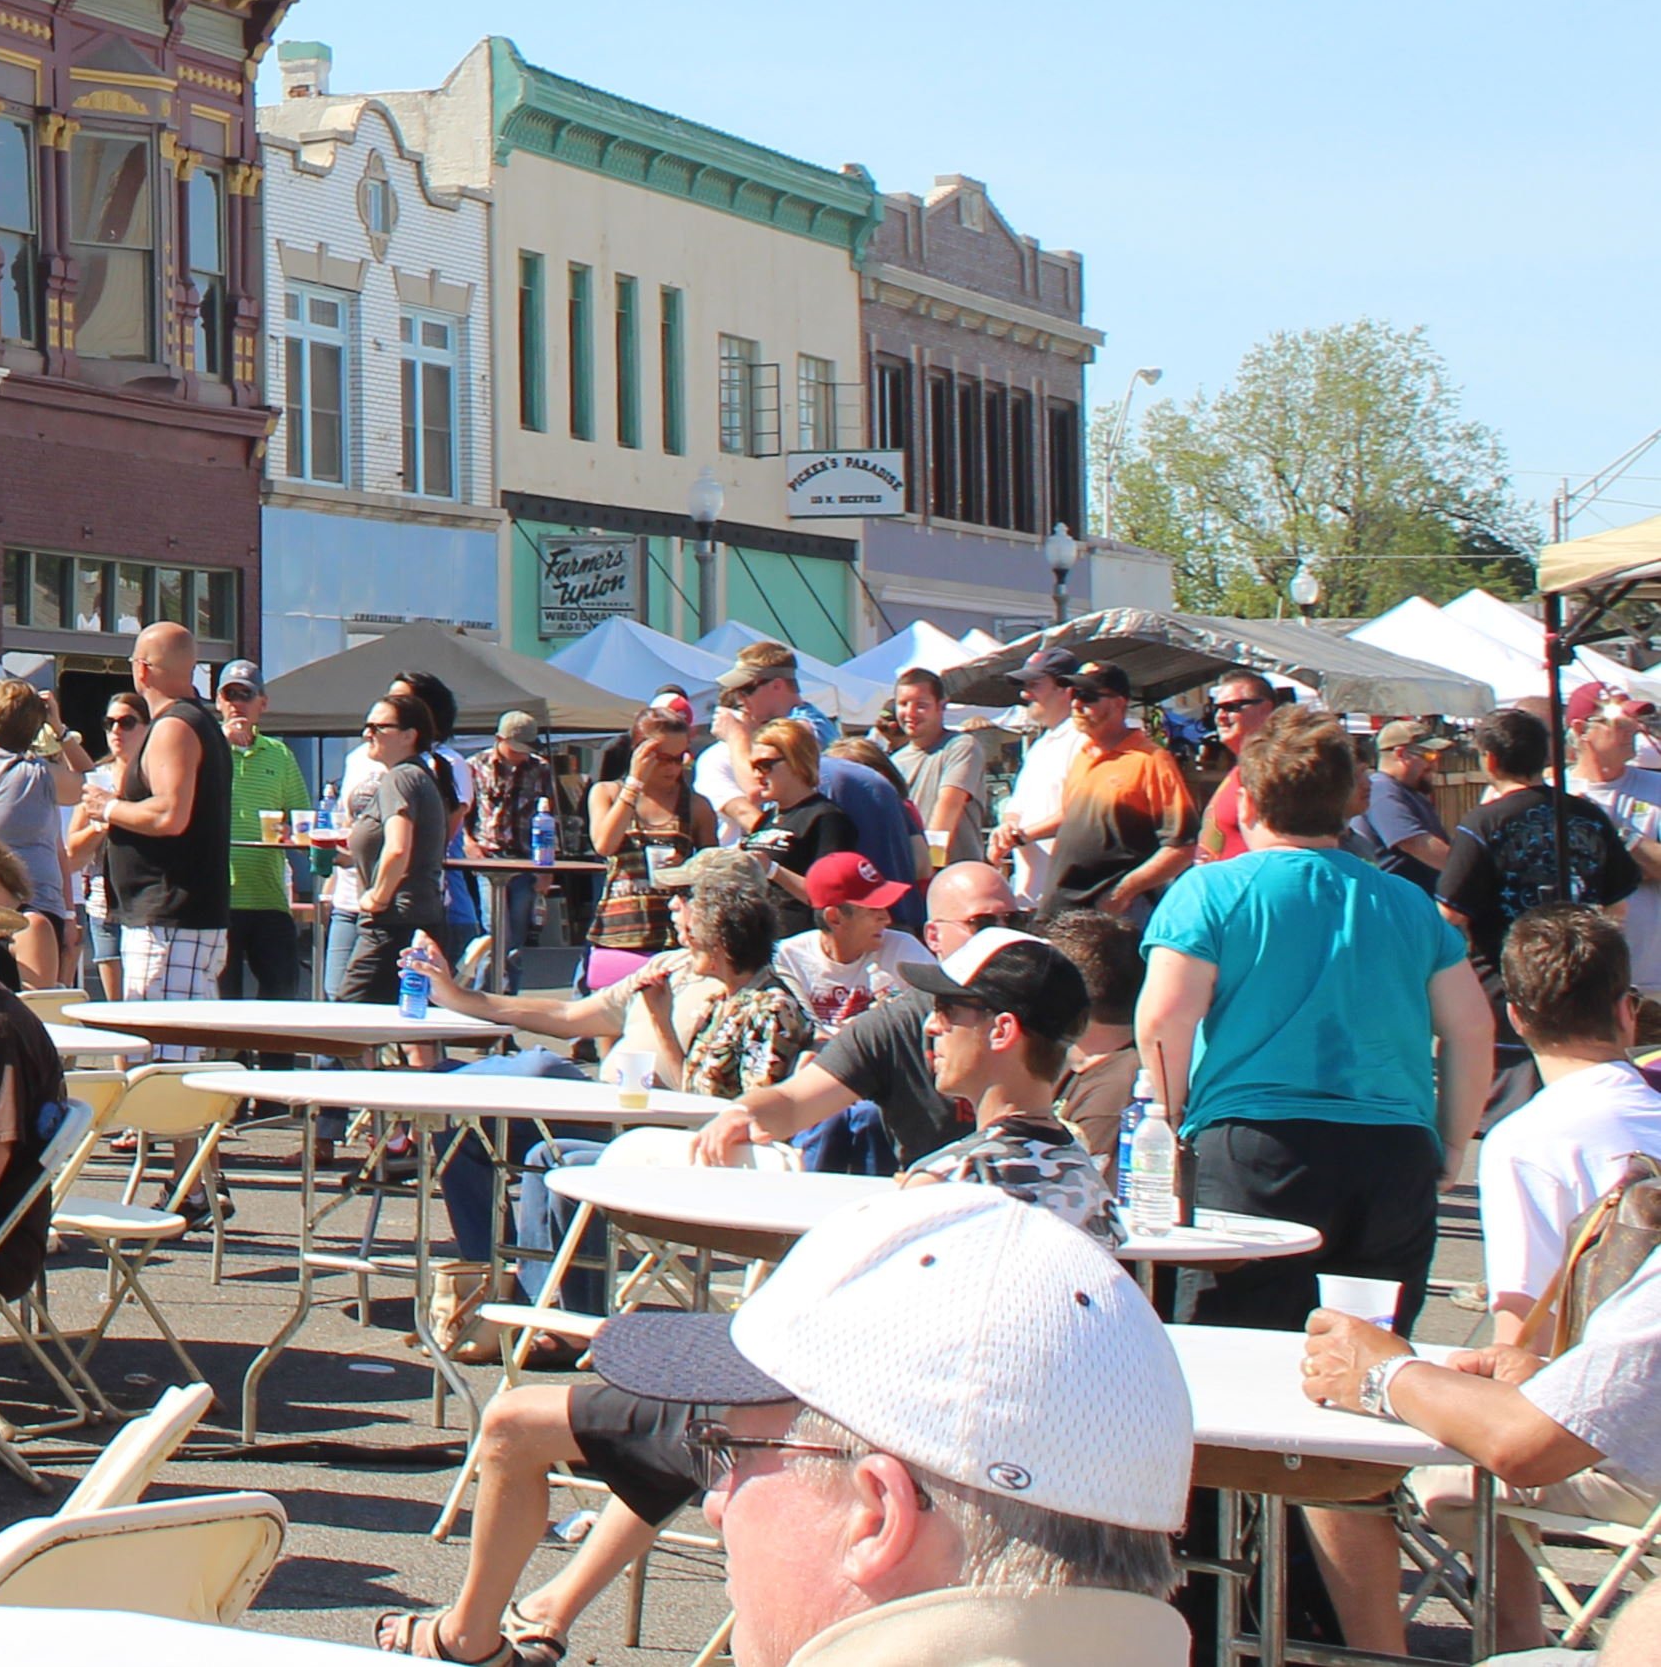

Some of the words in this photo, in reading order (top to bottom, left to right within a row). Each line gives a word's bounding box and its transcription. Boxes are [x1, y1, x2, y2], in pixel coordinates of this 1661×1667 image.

[844, 456, 904, 493] PARADISE
[545, 546, 624, 580] Farmers
[552, 573, 626, 606] Union
